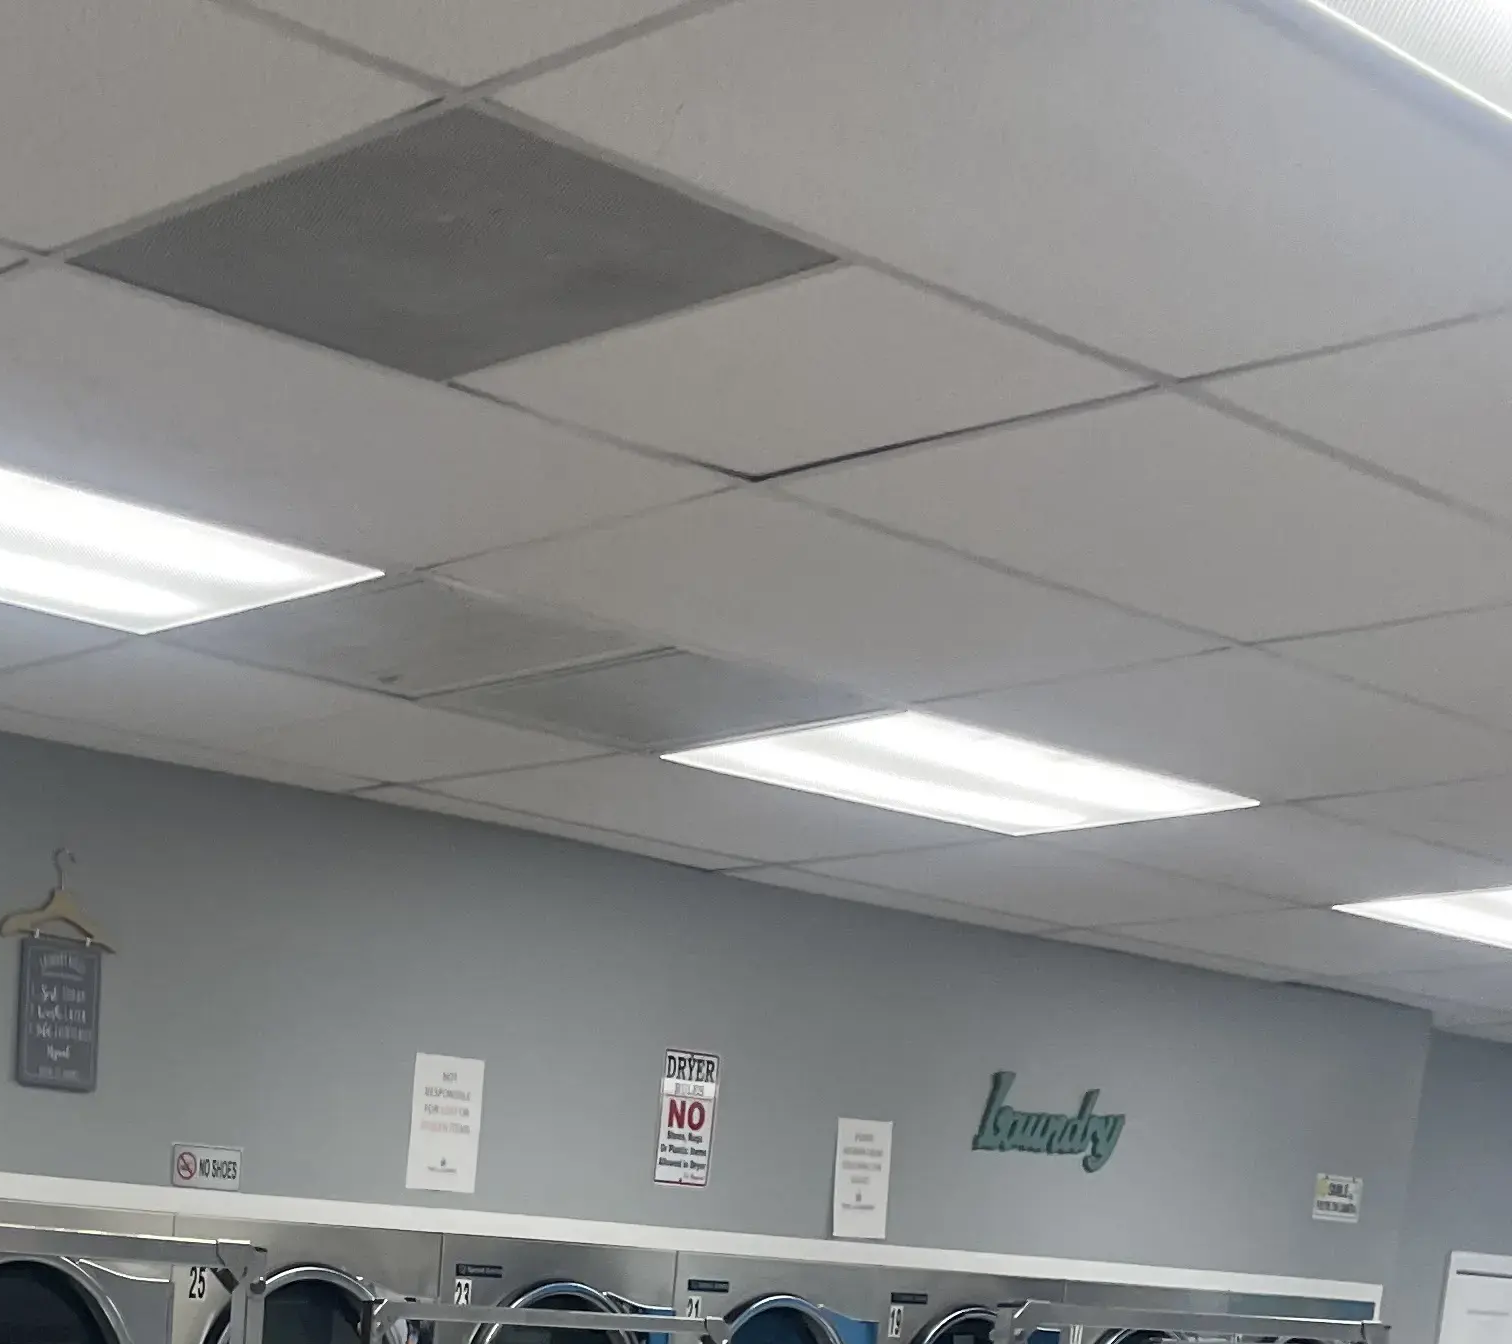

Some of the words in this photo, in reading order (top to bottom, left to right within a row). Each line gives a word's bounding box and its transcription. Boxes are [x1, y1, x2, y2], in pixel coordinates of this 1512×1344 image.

[666, 1055, 716, 1083] DRYER
[668, 1098, 706, 1131] NO
[199, 1158, 211, 1178] NO
[211, 1159, 237, 1180] SHOES
[188, 1266, 206, 1299] 25
[454, 1281, 470, 1305] 23
